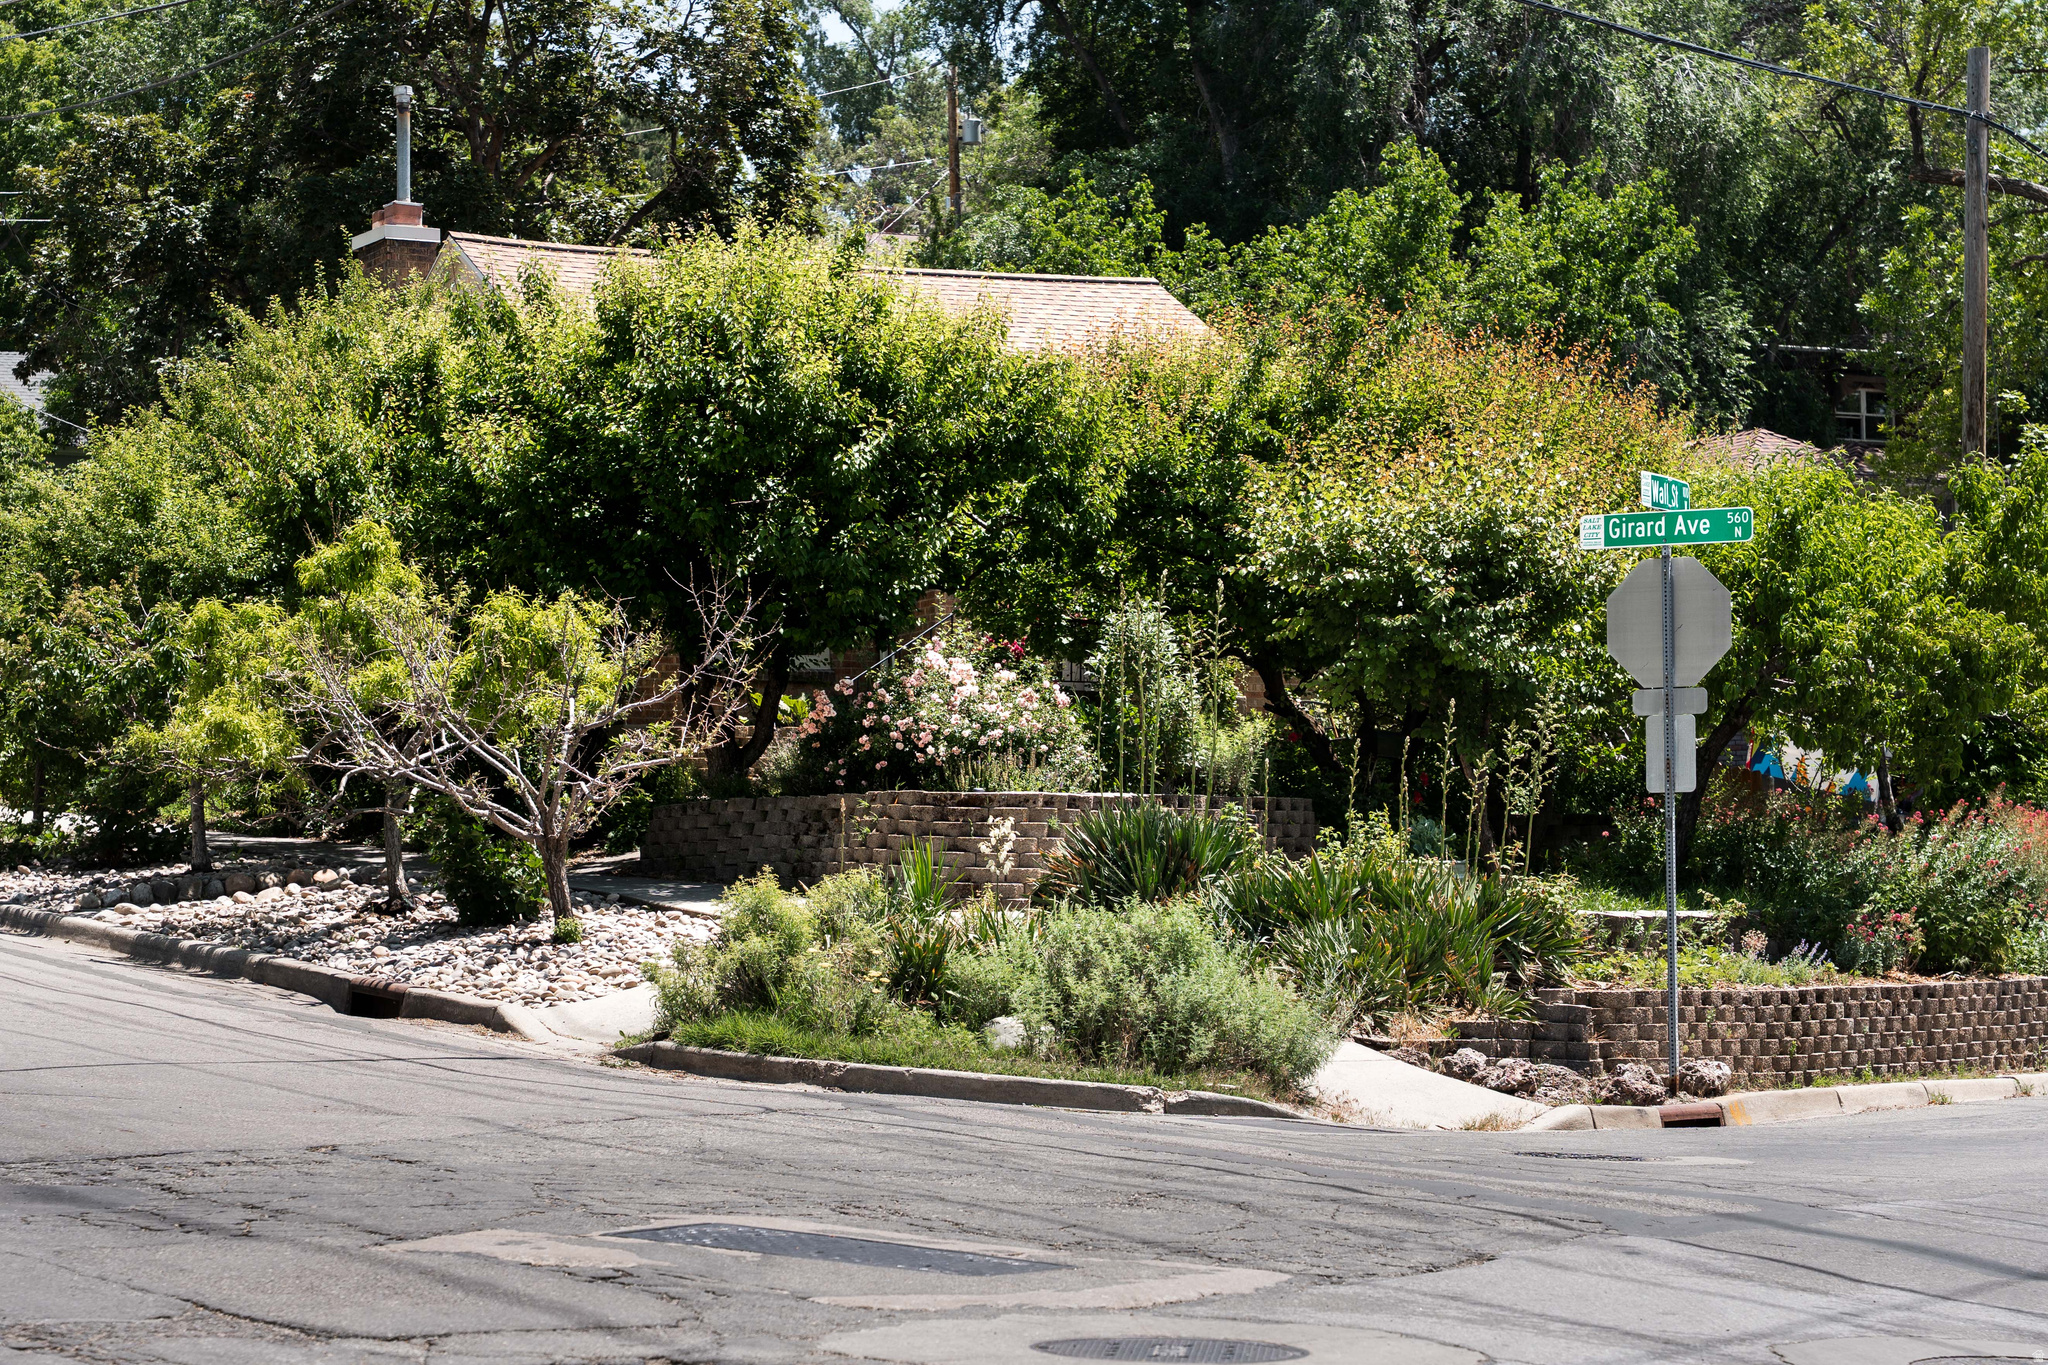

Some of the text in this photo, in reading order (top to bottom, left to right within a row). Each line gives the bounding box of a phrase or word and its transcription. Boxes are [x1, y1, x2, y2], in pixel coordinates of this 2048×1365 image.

[1652, 479, 1669, 505] Wall
[1671, 484, 1679, 508] St
[1609, 514, 1710, 539] Girard Ave
[1727, 511, 1749, 524] 560
[1734, 526, 1742, 537] N
